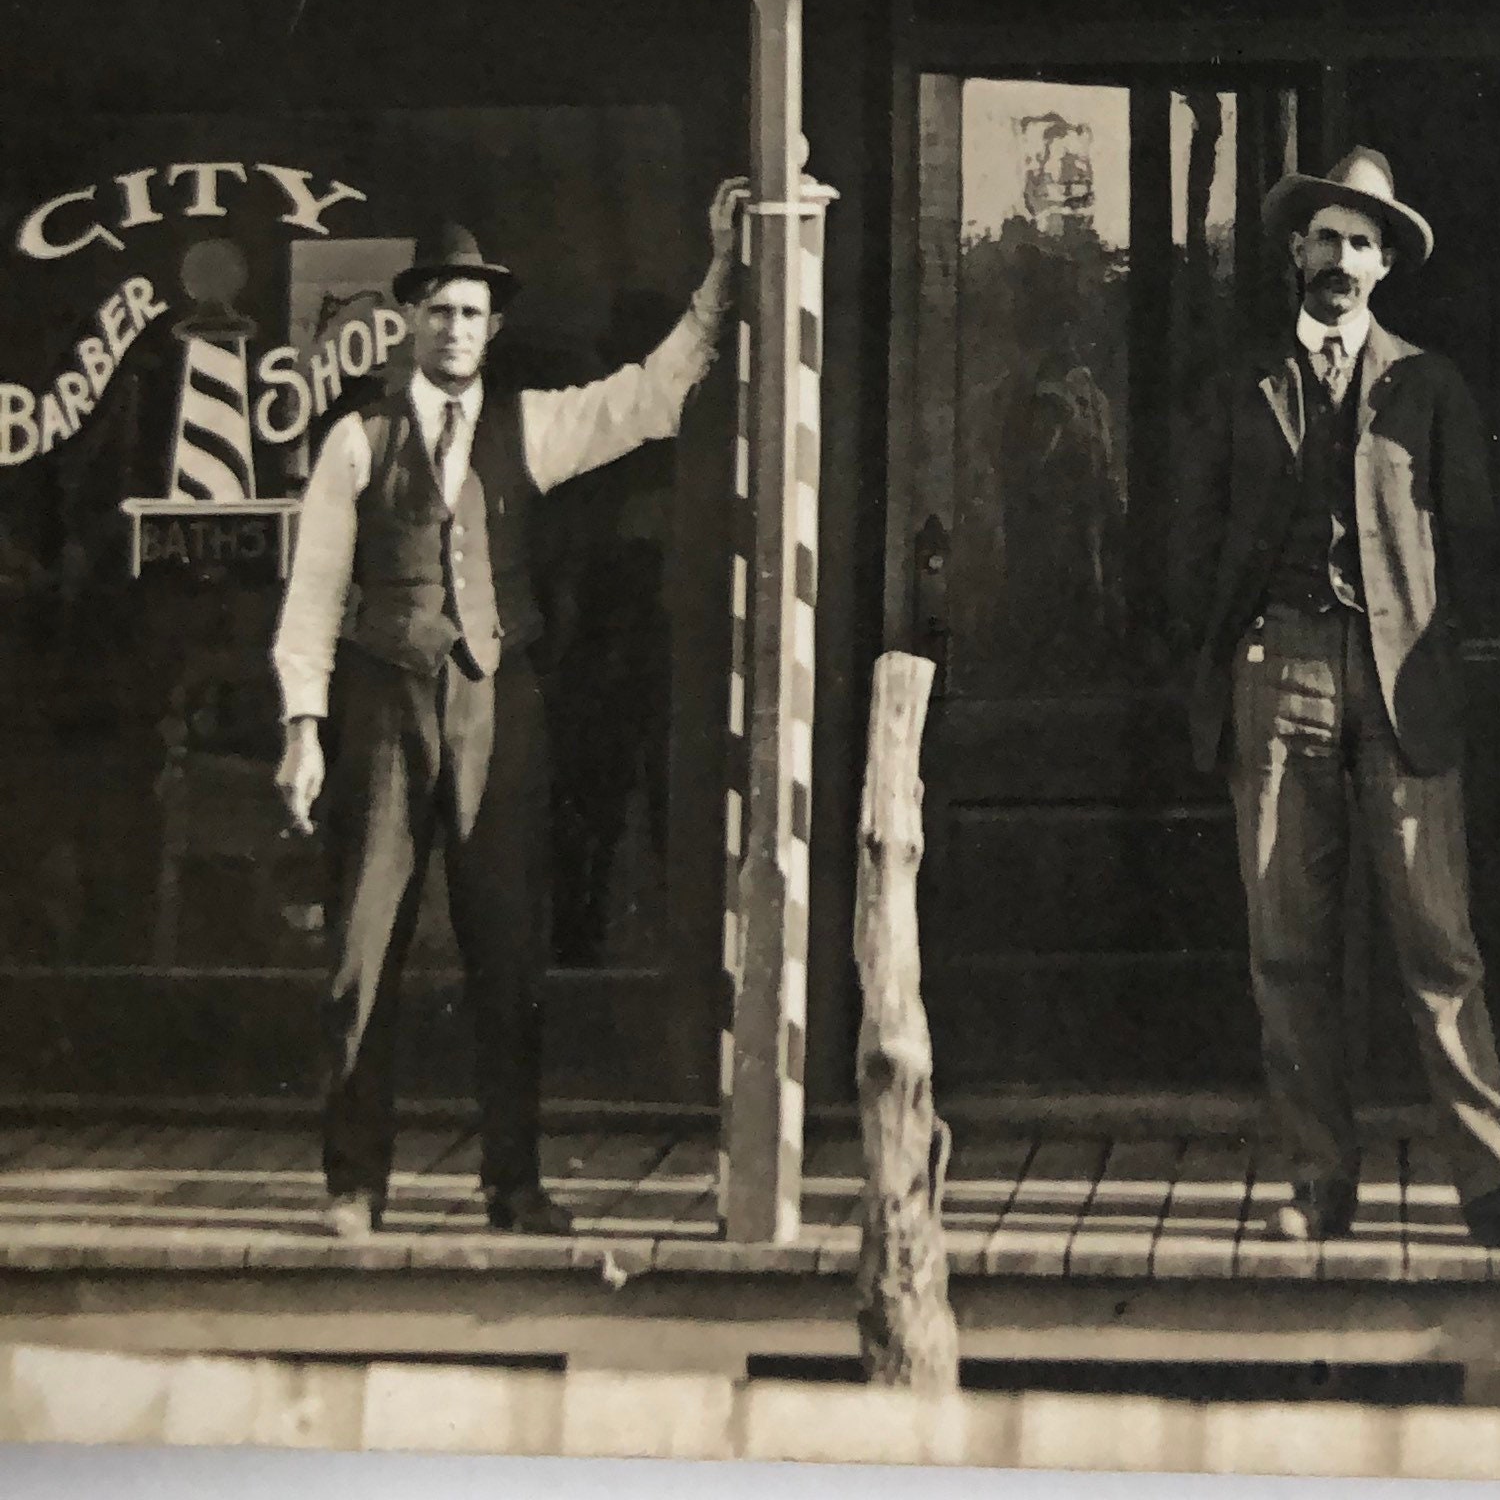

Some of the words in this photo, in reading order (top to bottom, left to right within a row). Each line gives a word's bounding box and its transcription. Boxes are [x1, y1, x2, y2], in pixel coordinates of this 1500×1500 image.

[15, 161, 367, 261] CITY
[0, 275, 168, 467] BARBER
[254, 307, 407, 444] SHOP
